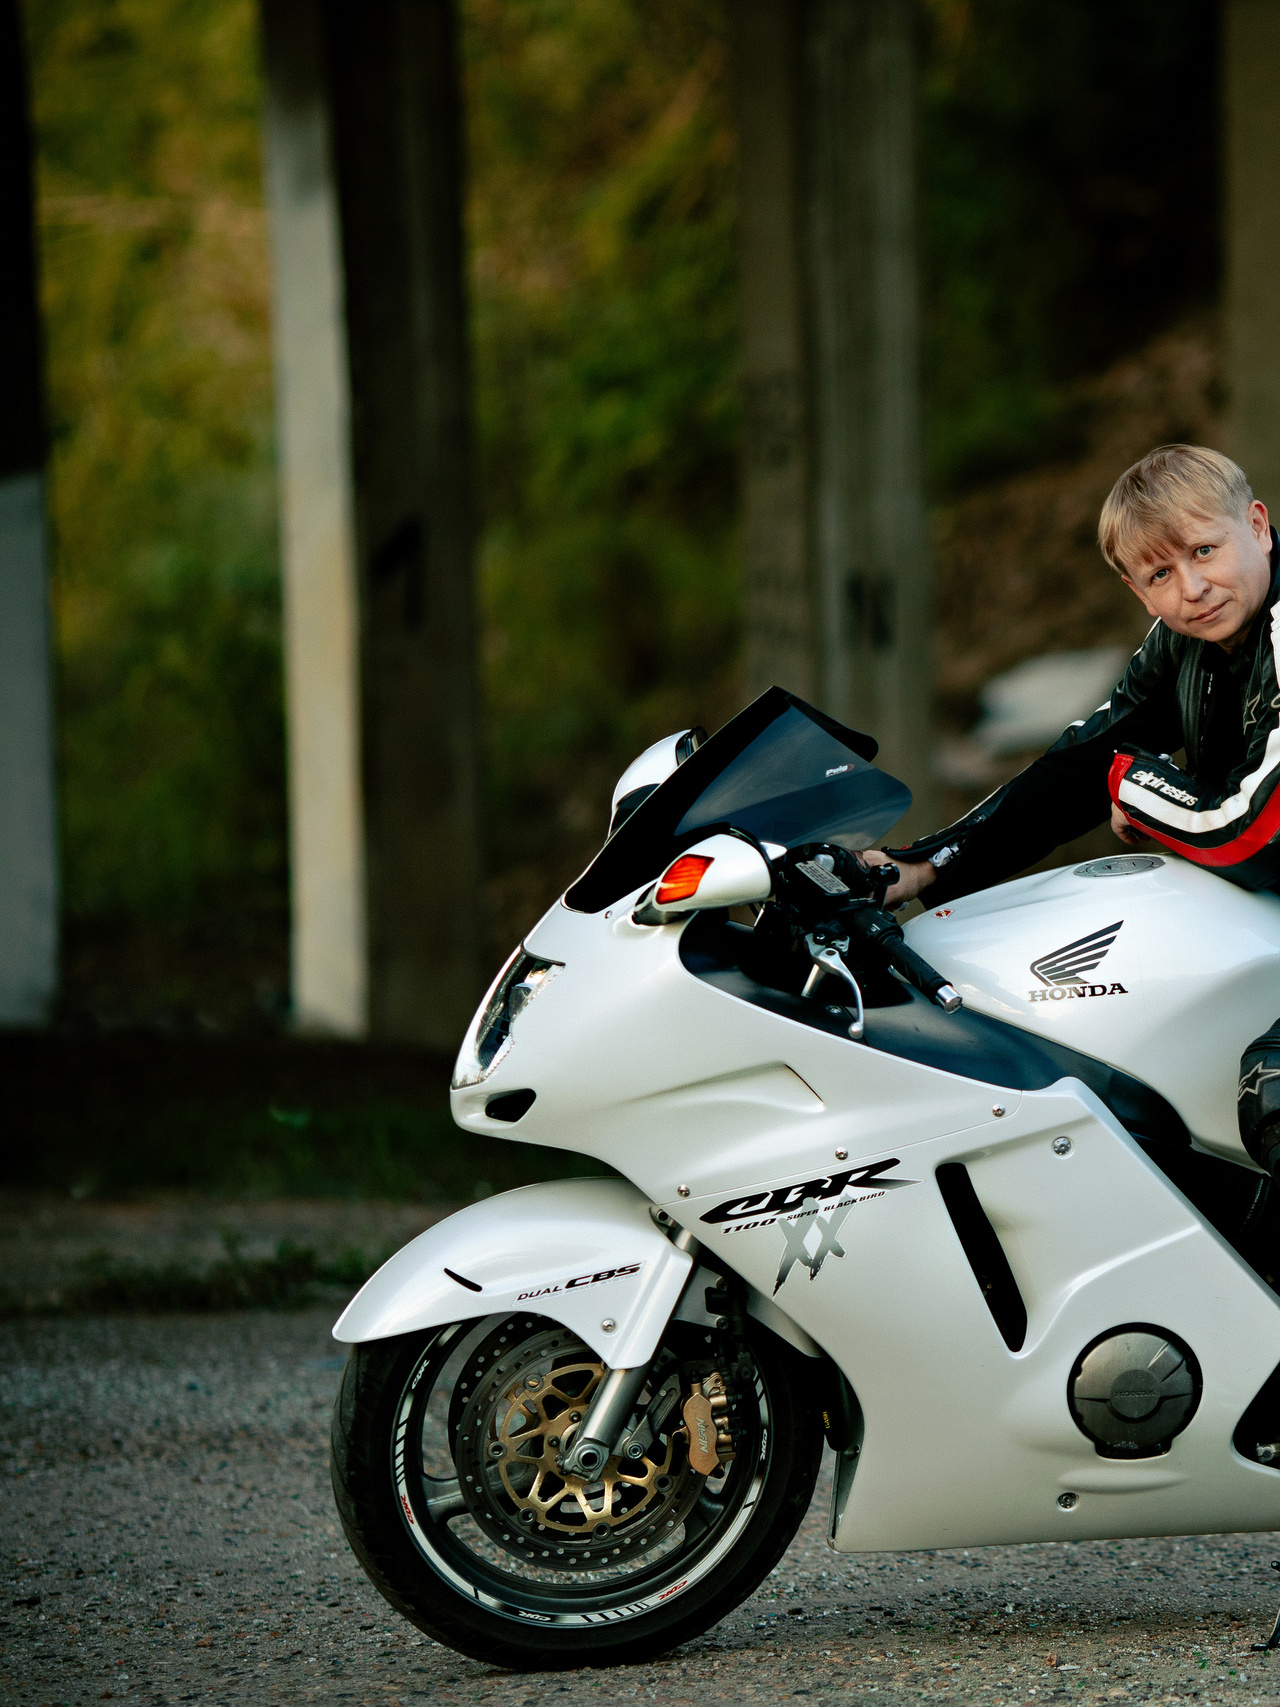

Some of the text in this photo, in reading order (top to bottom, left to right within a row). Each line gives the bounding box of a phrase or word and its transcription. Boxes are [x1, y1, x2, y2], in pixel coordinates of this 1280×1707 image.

[1131, 769, 1199, 807] alpinestars
[1028, 983, 1129, 1002] HONDA
[699, 1157, 925, 1224] CBR
[722, 1218, 777, 1234] 1100
[786, 1208, 820, 1221] SUPER
[772, 1193, 857, 1297] XX
[517, 1262, 642, 1301] DUAL CBS
